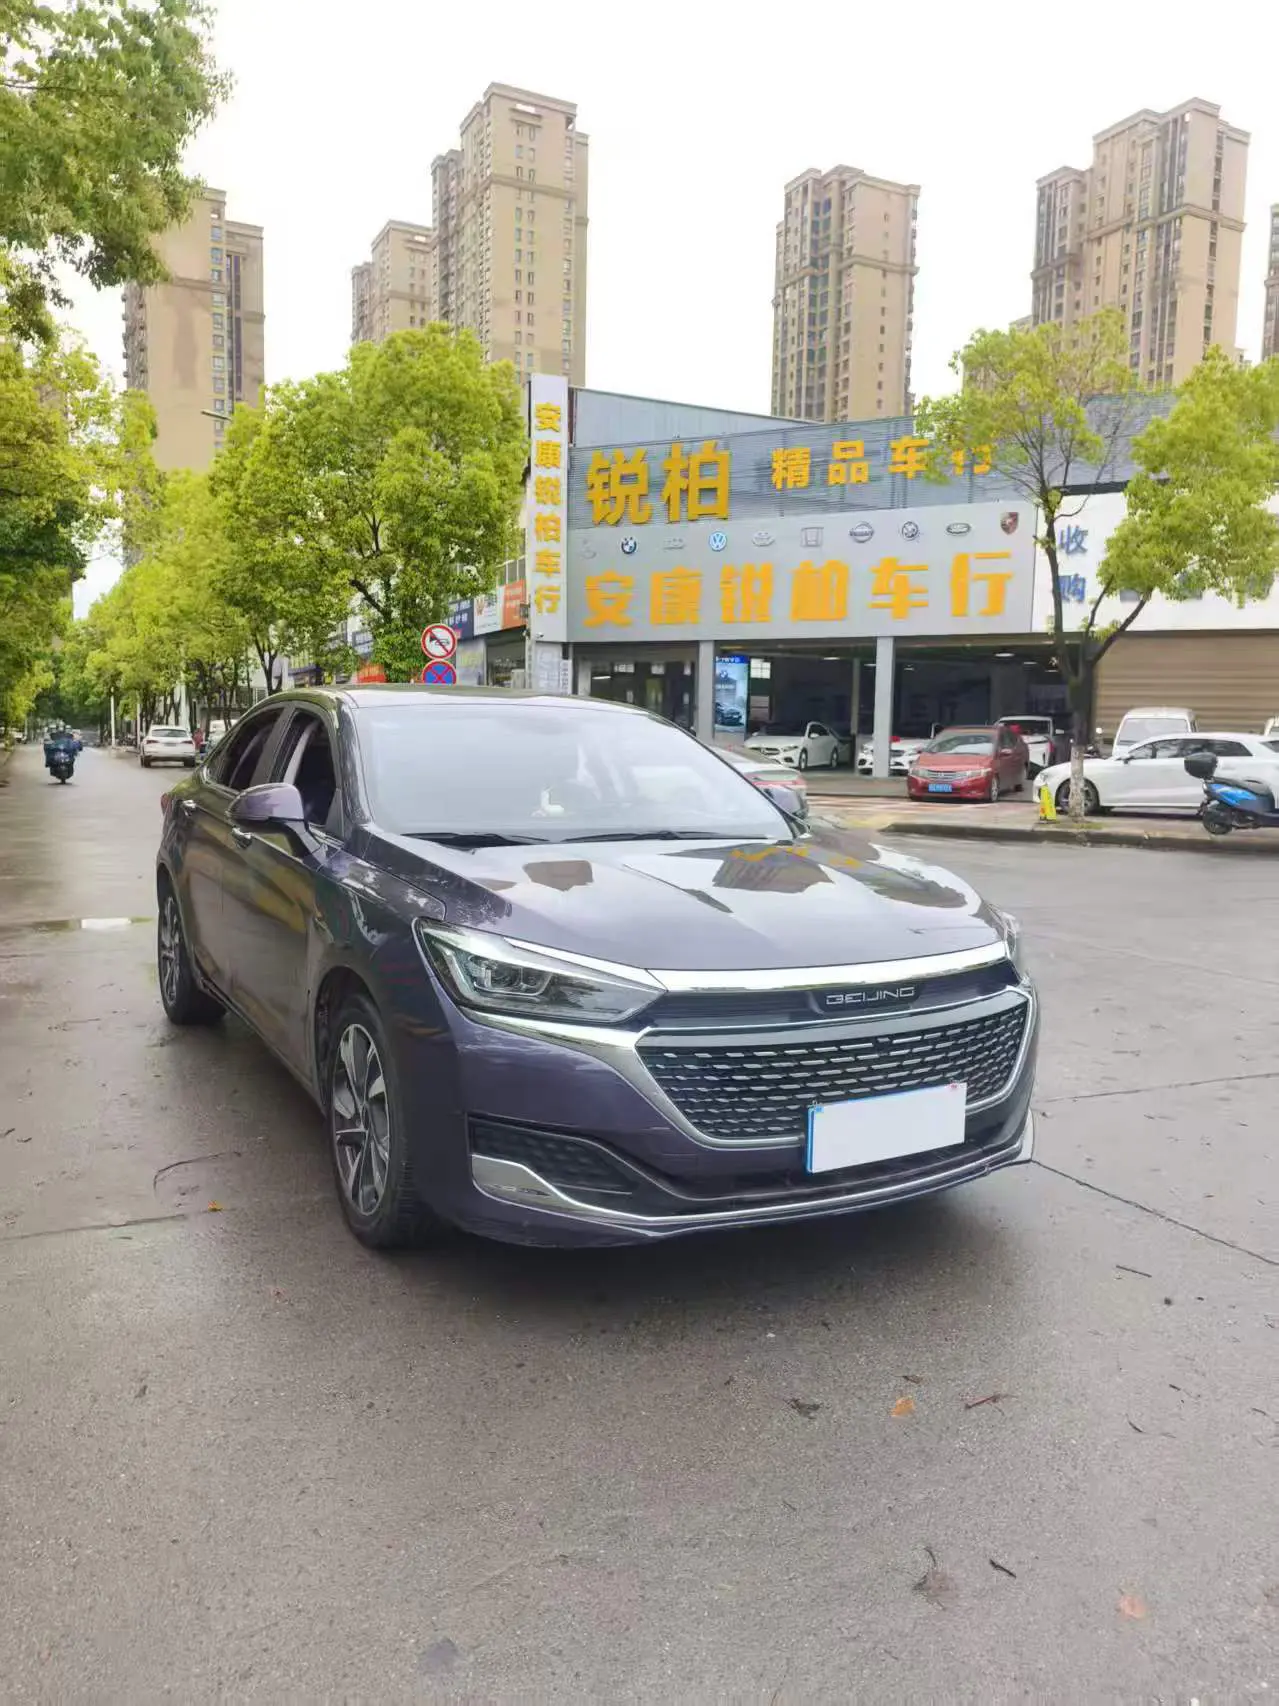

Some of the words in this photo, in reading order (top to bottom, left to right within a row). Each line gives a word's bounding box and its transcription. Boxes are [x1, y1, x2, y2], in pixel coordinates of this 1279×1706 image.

[585, 440, 731, 527] 锐柏
[582, 551, 1013, 628] 安康锐柏车行
[826, 986, 915, 1005] BEIJING
